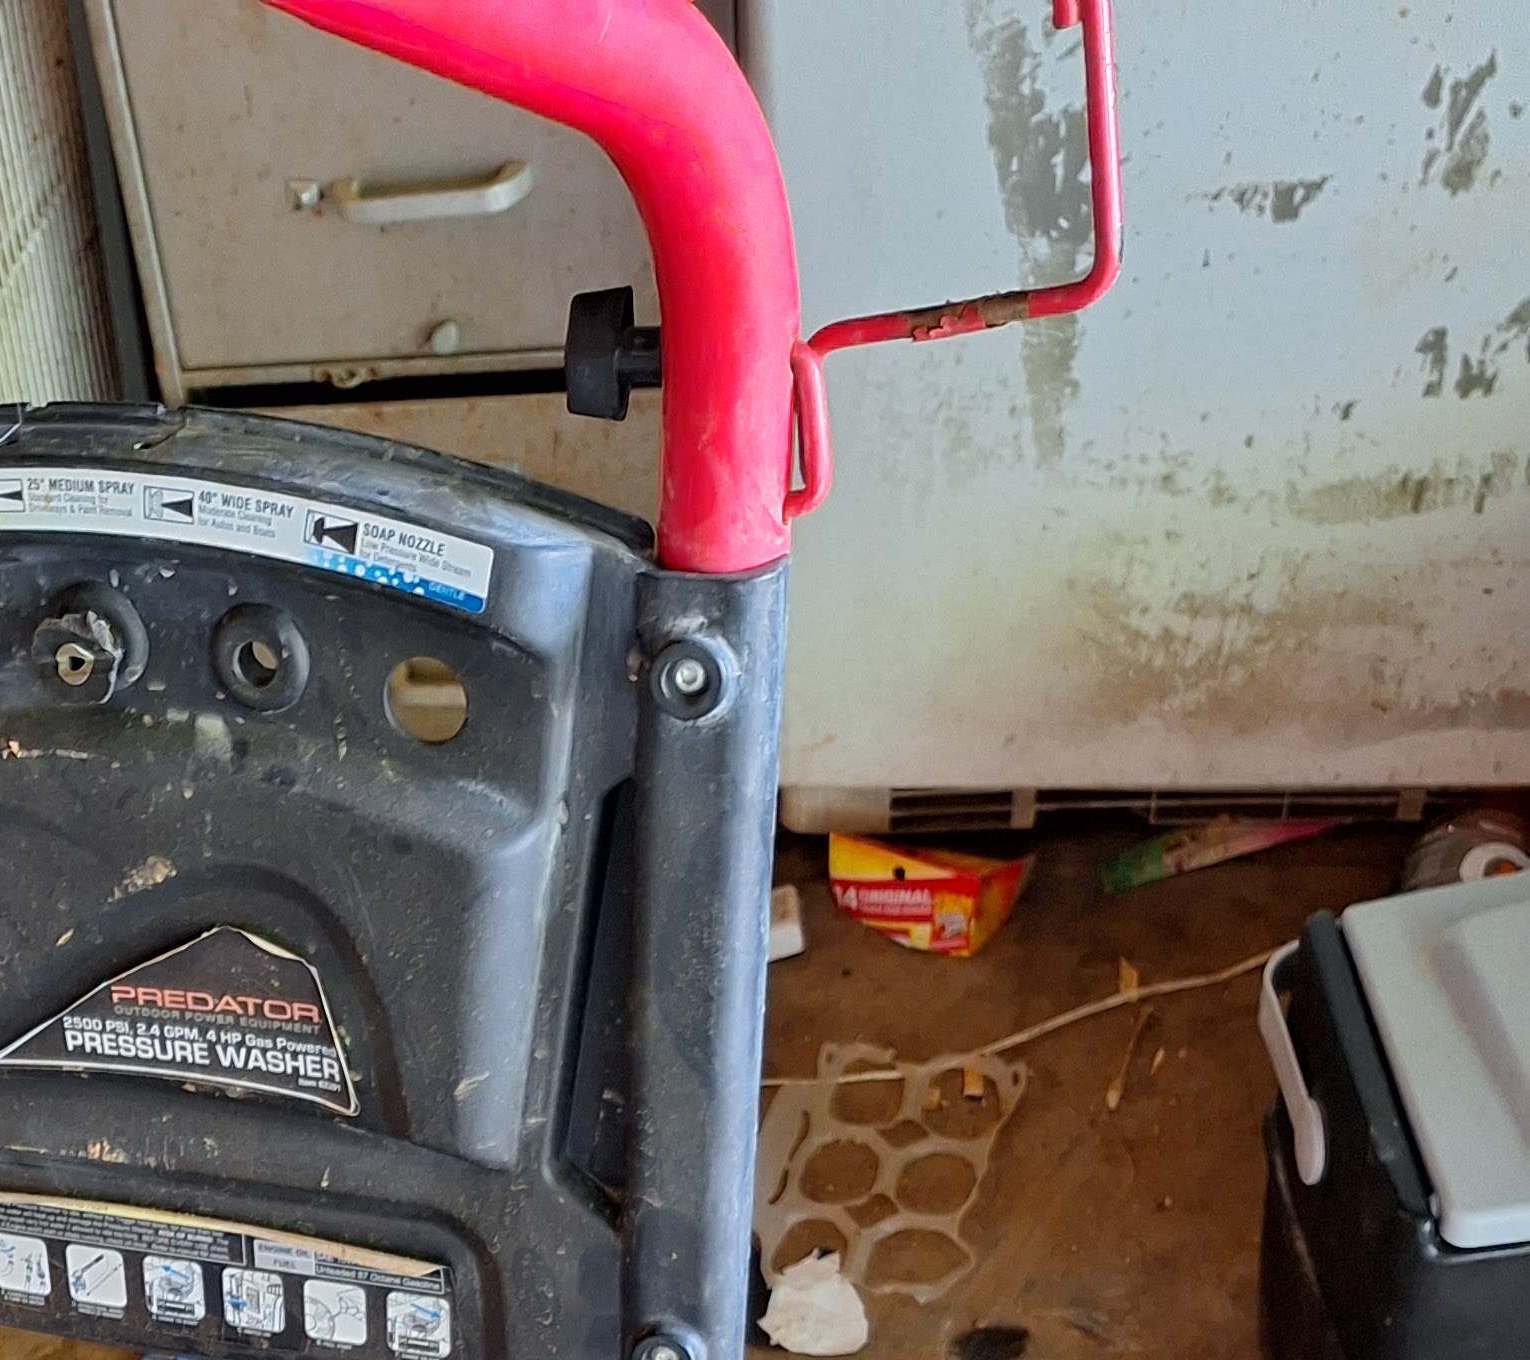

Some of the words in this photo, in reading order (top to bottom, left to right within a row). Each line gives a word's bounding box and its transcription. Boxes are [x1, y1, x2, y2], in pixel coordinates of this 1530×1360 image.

[48, 477, 94, 492] MEDIUM
[97, 479, 134, 494] SPRAY
[220, 492, 252, 510] WIDE
[254, 498, 294, 518] SPRAY
[362, 522, 396, 542] SOAP
[397, 531, 446, 556] NOZZLE
[859, 889, 932, 904] ORIGINAL
[110, 986, 320, 1024] PREDATOR
[113, 1005, 180, 1021] OUTDOOR
[185, 1011, 235, 1025] POWER
[240, 1017, 320, 1035] EQUIPMENT
[63, 1016, 102, 1031] 2500
[137, 1024, 160, 1037] 2.4
[206, 1031, 217, 1043] 4
[220, 1032, 242, 1045] HP
[245, 1034, 272, 1049] Gas
[276, 1037, 336, 1057] Powered
[65, 1030, 210, 1064] PRESSURE
[219, 1045, 340, 1082] WASHER
[257, 1241, 295, 1255] ENGINE
[272, 1258, 297, 1270] FUEL
[315, 1264, 356, 1278] Unleaded
[356, 1271, 368, 1280] 87
[368, 1273, 401, 1285] Octane
[401, 1278, 440, 1291] Gasoline
